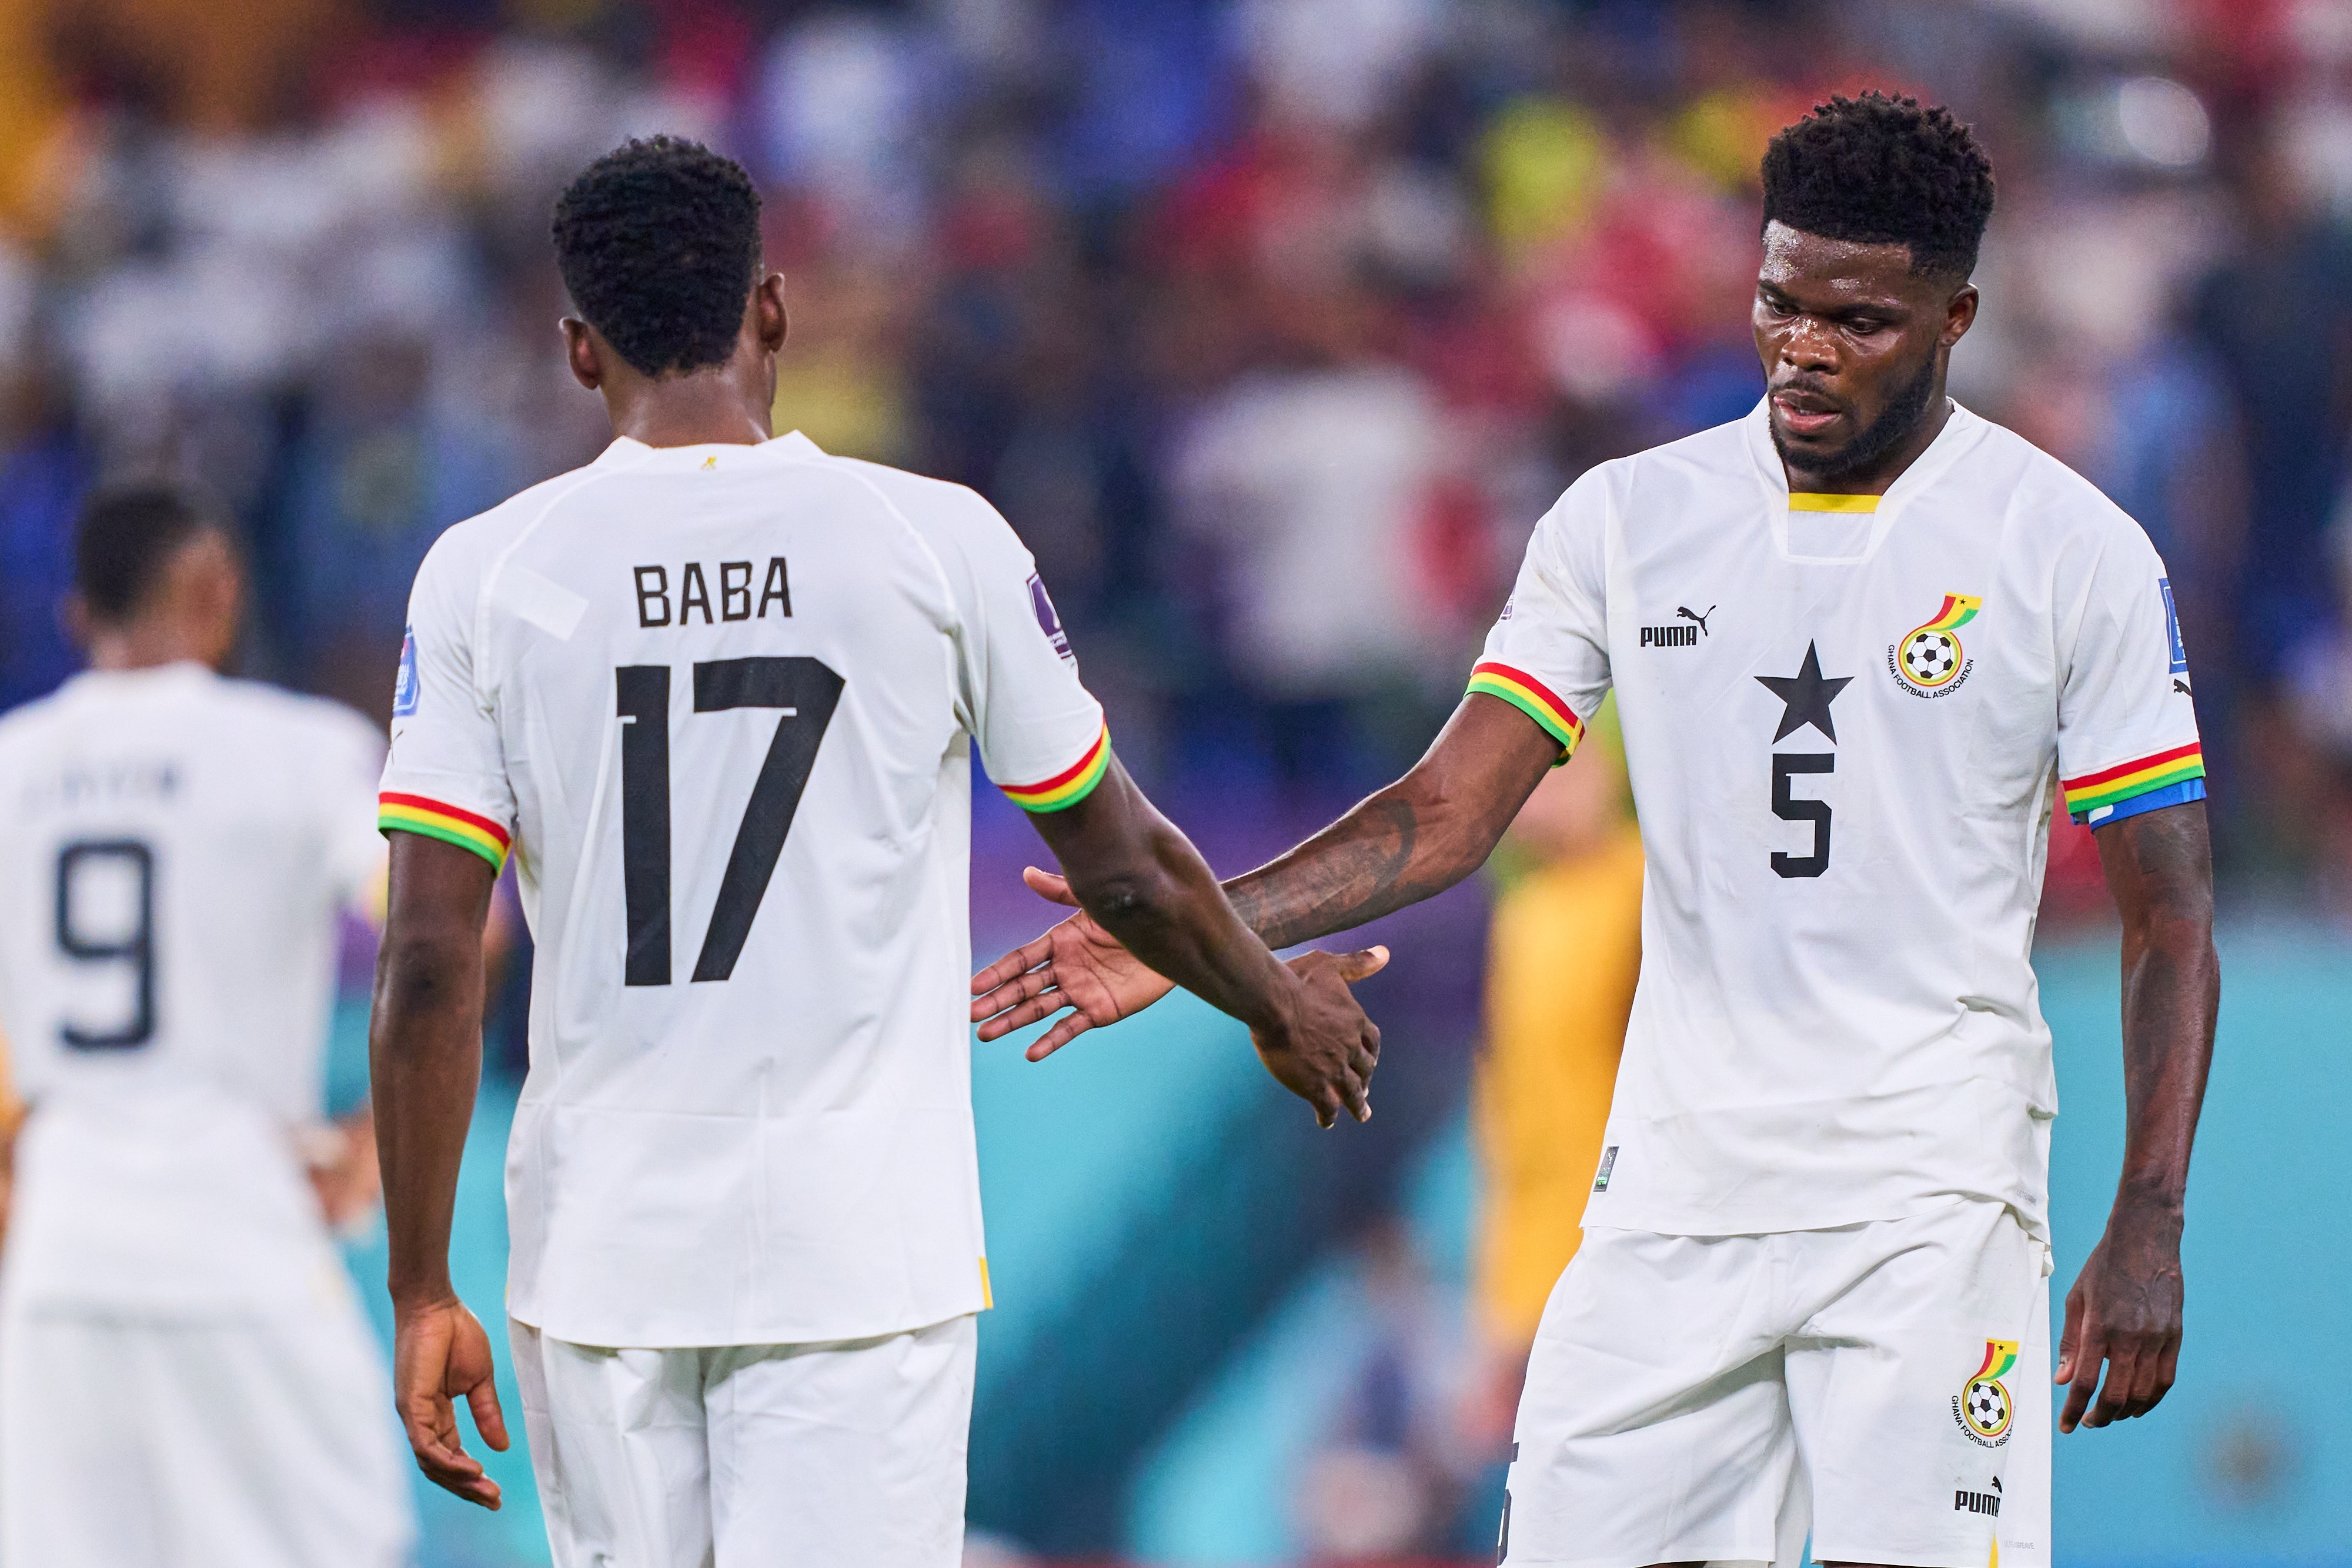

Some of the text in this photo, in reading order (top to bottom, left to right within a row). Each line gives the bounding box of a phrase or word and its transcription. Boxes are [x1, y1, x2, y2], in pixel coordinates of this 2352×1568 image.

[634, 557, 793, 628] BABA
[1641, 626, 1698, 647] PUMA
[1887, 644, 1974, 699] GHANA FOOTBALL ASSOCIATION
[615, 656, 846, 987] 17
[1770, 753, 1835, 878] 5
[56, 840, 155, 1052] 9
[1952, 1395, 1963, 1426] GHANA
[1960, 1425, 1994, 1448] FOOTBALL
